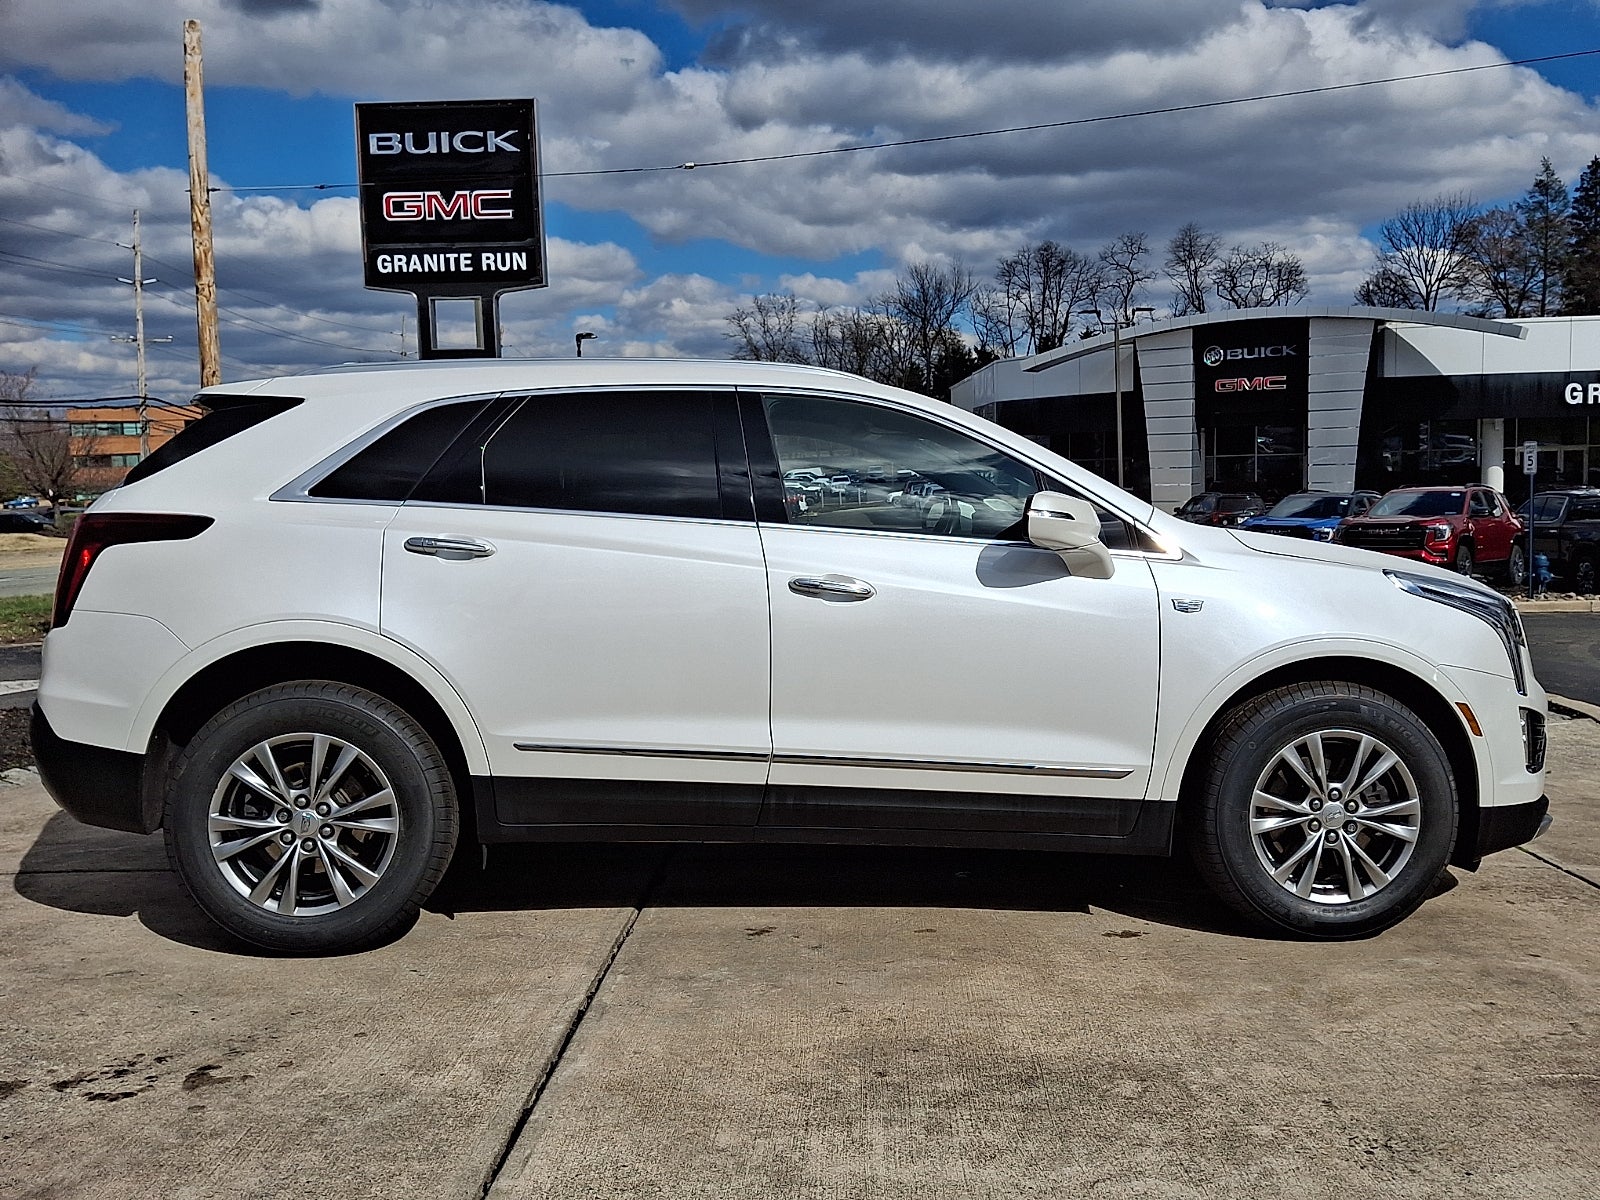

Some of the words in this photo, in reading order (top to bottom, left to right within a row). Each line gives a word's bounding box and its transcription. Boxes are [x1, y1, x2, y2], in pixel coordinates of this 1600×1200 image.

[368, 129, 521, 155] BUICK
[382, 189, 514, 221] GMC
[376, 253, 473, 274] GRANITE
[481, 252, 527, 272] RUN
[1226, 344, 1297, 360] BUICK
[1215, 376, 1287, 393] GMC
[1527, 455, 1534, 467] 5
